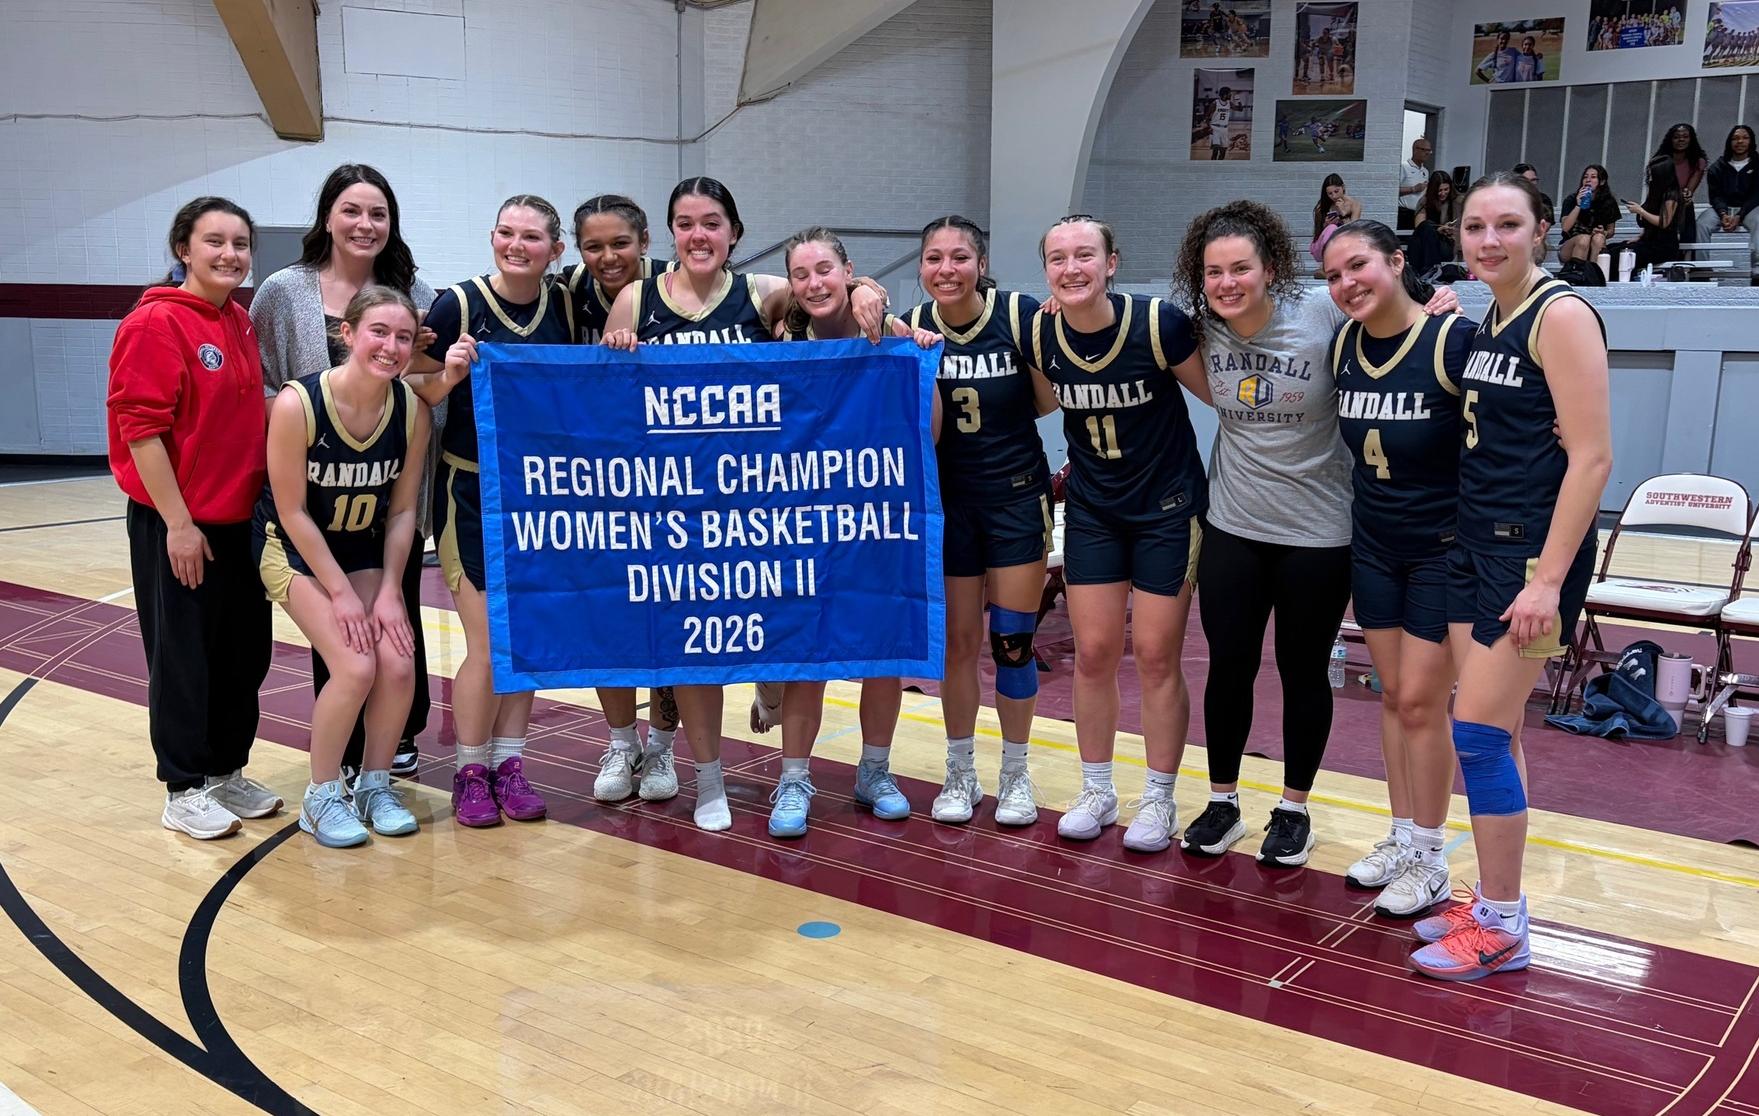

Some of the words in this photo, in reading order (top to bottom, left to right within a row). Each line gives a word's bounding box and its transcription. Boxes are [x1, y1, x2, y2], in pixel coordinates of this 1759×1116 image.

[1210, 352, 1311, 381] RANDALL
[644, 383, 781, 426] NCCAA
[952, 387, 981, 433] 3
[1280, 391, 1305, 403] 1959
[1338, 390, 1431, 420] ANDALL
[1085, 415, 1122, 460] 11
[1463, 389, 1479, 450] 5
[523, 455, 704, 497] REGIONAL
[717, 447, 905, 495] CHAMPION
[1363, 428, 1391, 479] 4
[327, 494, 377, 532] 10
[1645, 499, 1686, 507] ADVENTIST
[1687, 501, 1731, 509] UNIVERSITY
[1646, 491, 1733, 504] SOUTHWESTERN
[511, 510, 689, 552] WOMEN'S
[702, 501, 919, 549] BASKETBALL
[627, 560, 782, 603] DIVISION
[796, 558, 816, 596] II
[683, 612, 765, 654] 2026
